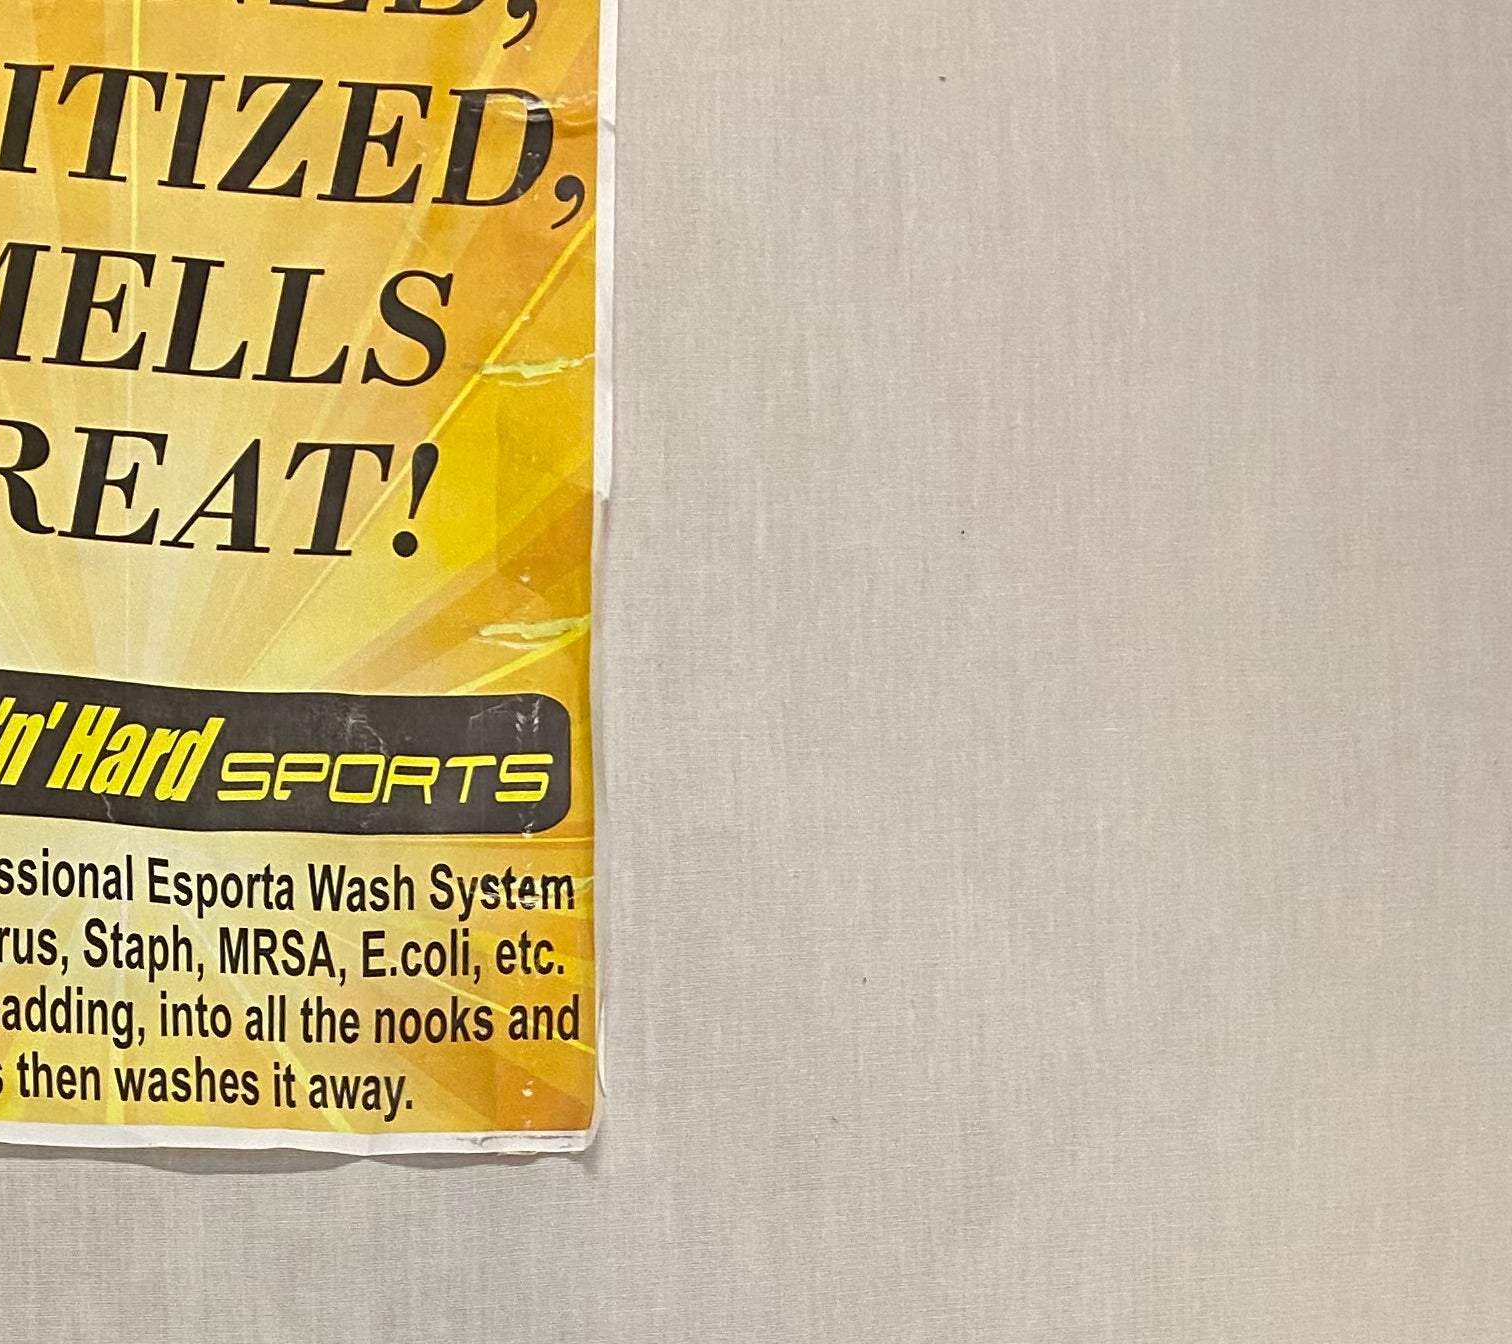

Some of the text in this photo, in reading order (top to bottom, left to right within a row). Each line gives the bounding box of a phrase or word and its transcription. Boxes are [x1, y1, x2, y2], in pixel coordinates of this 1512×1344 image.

[46, 704, 225, 801] Hard
[217, 752, 553, 804] SPORTS
[147, 856, 295, 920] Esporta
[307, 863, 415, 913] Wash
[429, 863, 574, 922] System
[83, 917, 204, 983] Staph,
[219, 926, 346, 987] MRSA,
[362, 927, 481, 985] E.coli,
[496, 930, 564, 975] etc.
[160, 990, 232, 1039] into
[245, 994, 286, 1043] all
[300, 995, 360, 1044] the
[374, 995, 494, 1045] nooks
[508, 993, 579, 1041] and
[16, 1051, 101, 1101] then
[113, 1055, 260, 1106] washes
[273, 1061, 297, 1109] it
[308, 1074, 413, 1123] away.
